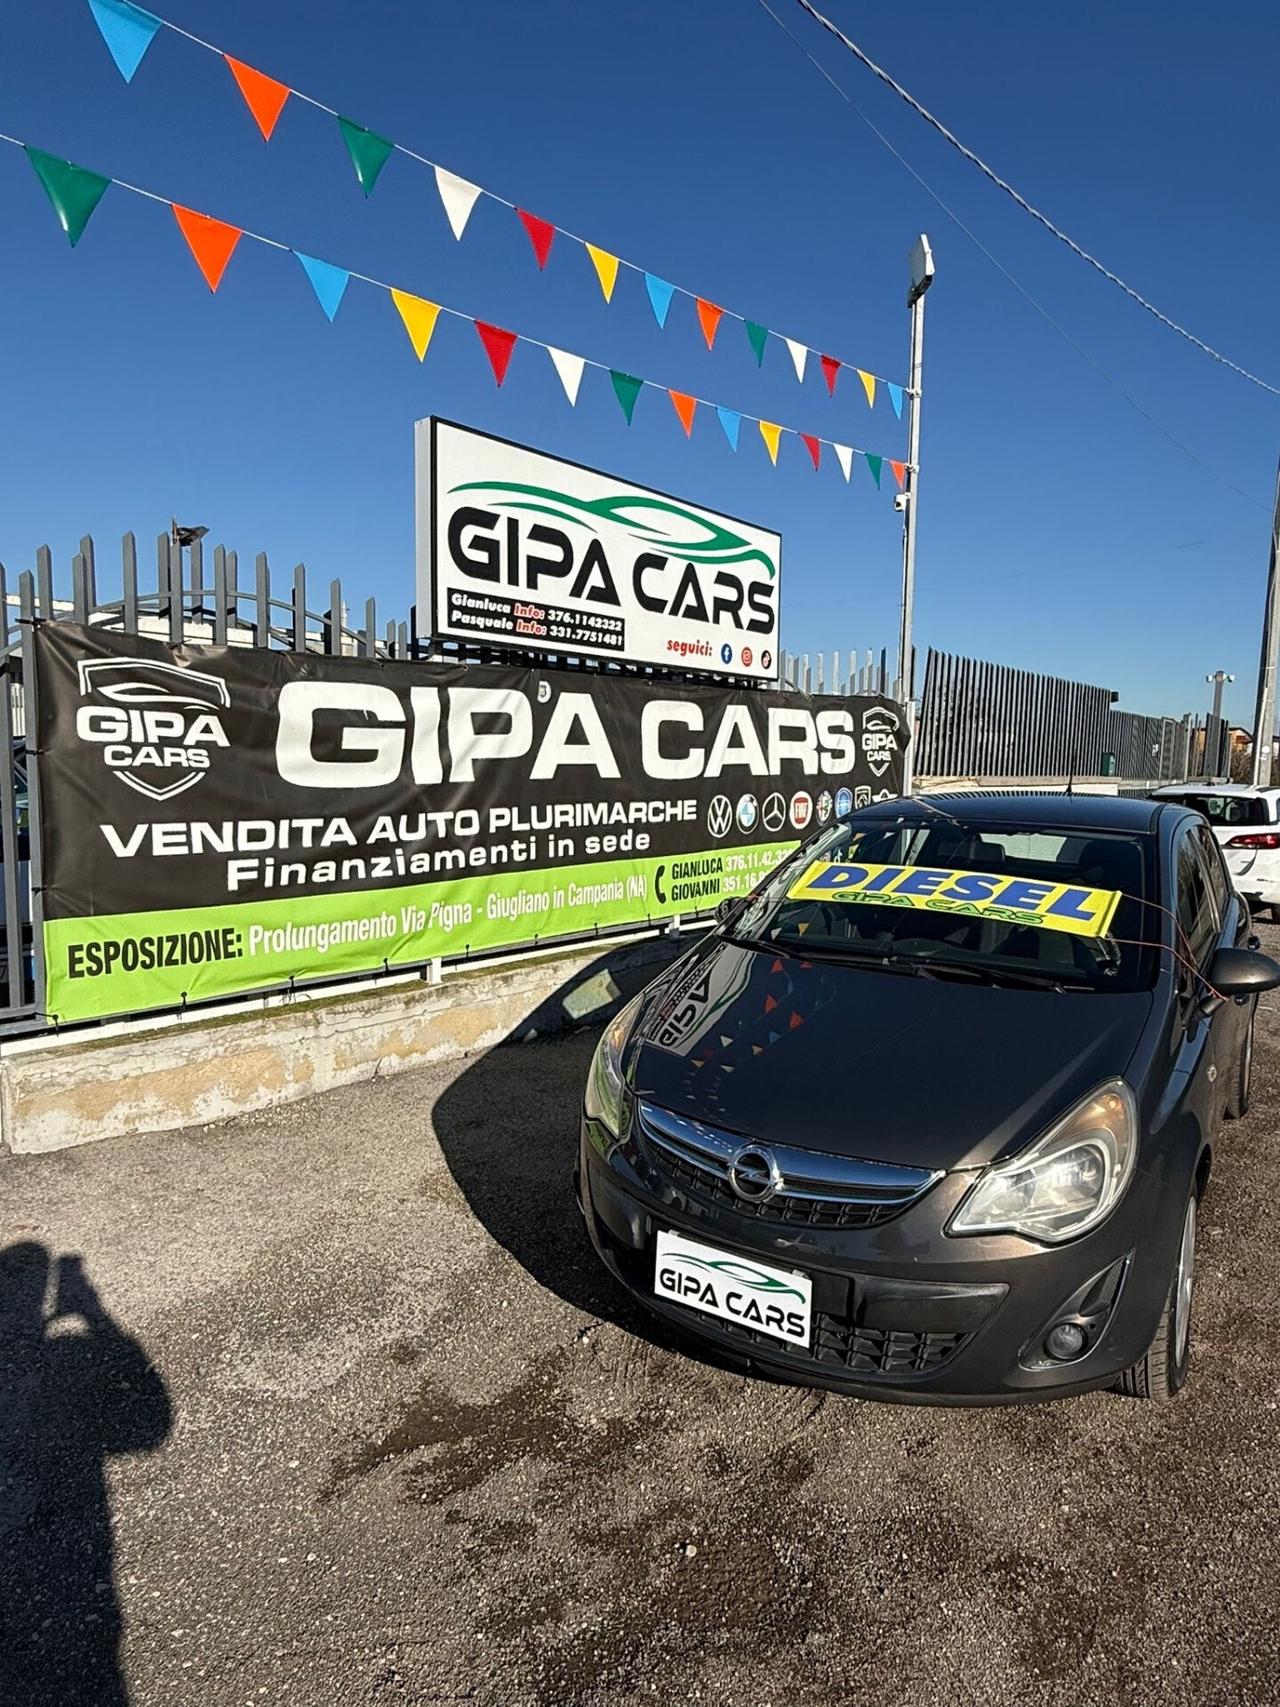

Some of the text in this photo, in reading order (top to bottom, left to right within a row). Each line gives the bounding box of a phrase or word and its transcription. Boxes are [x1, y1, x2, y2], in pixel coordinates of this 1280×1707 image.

[447, 506, 775, 635] GIPA CARS
[451, 593, 623, 632] Gianluca Info: 376.1142322
[451, 610, 623, 647] Pasquale Info: 331.7751481
[666, 638, 713, 658] seguici:
[76, 704, 231, 747] GIPA
[275, 681, 855, 788] GIPA CARS
[862, 733, 898, 751] GIPA
[104, 745, 210, 768] CARS
[867, 750, 892, 761] CARS
[100, 816, 357, 858] VENDITA
[366, 809, 480, 844] AUTO
[489, 800, 698, 833] PLURIMARCHE
[227, 829, 651, 891] Finanziamenti in sede
[672, 857, 723, 880] GIANLUCA
[671, 878, 720, 902] GIOVANNI
[807, 865, 1100, 921] DIESEL
[832, 891, 1045, 926] GIPA CARS
[68, 928, 243, 979] ESPOSIZIONE:
[249, 911, 397, 956] Prolungamento
[401, 906, 426, 935] Via
[427, 901, 473, 932] Pigna
[487, 890, 550, 921] Giugliano
[553, 884, 564, 908] in
[568, 881, 624, 906] Campania
[627, 875, 648, 900] (NA)
[660, 1268, 805, 1338] GIPA CARS
